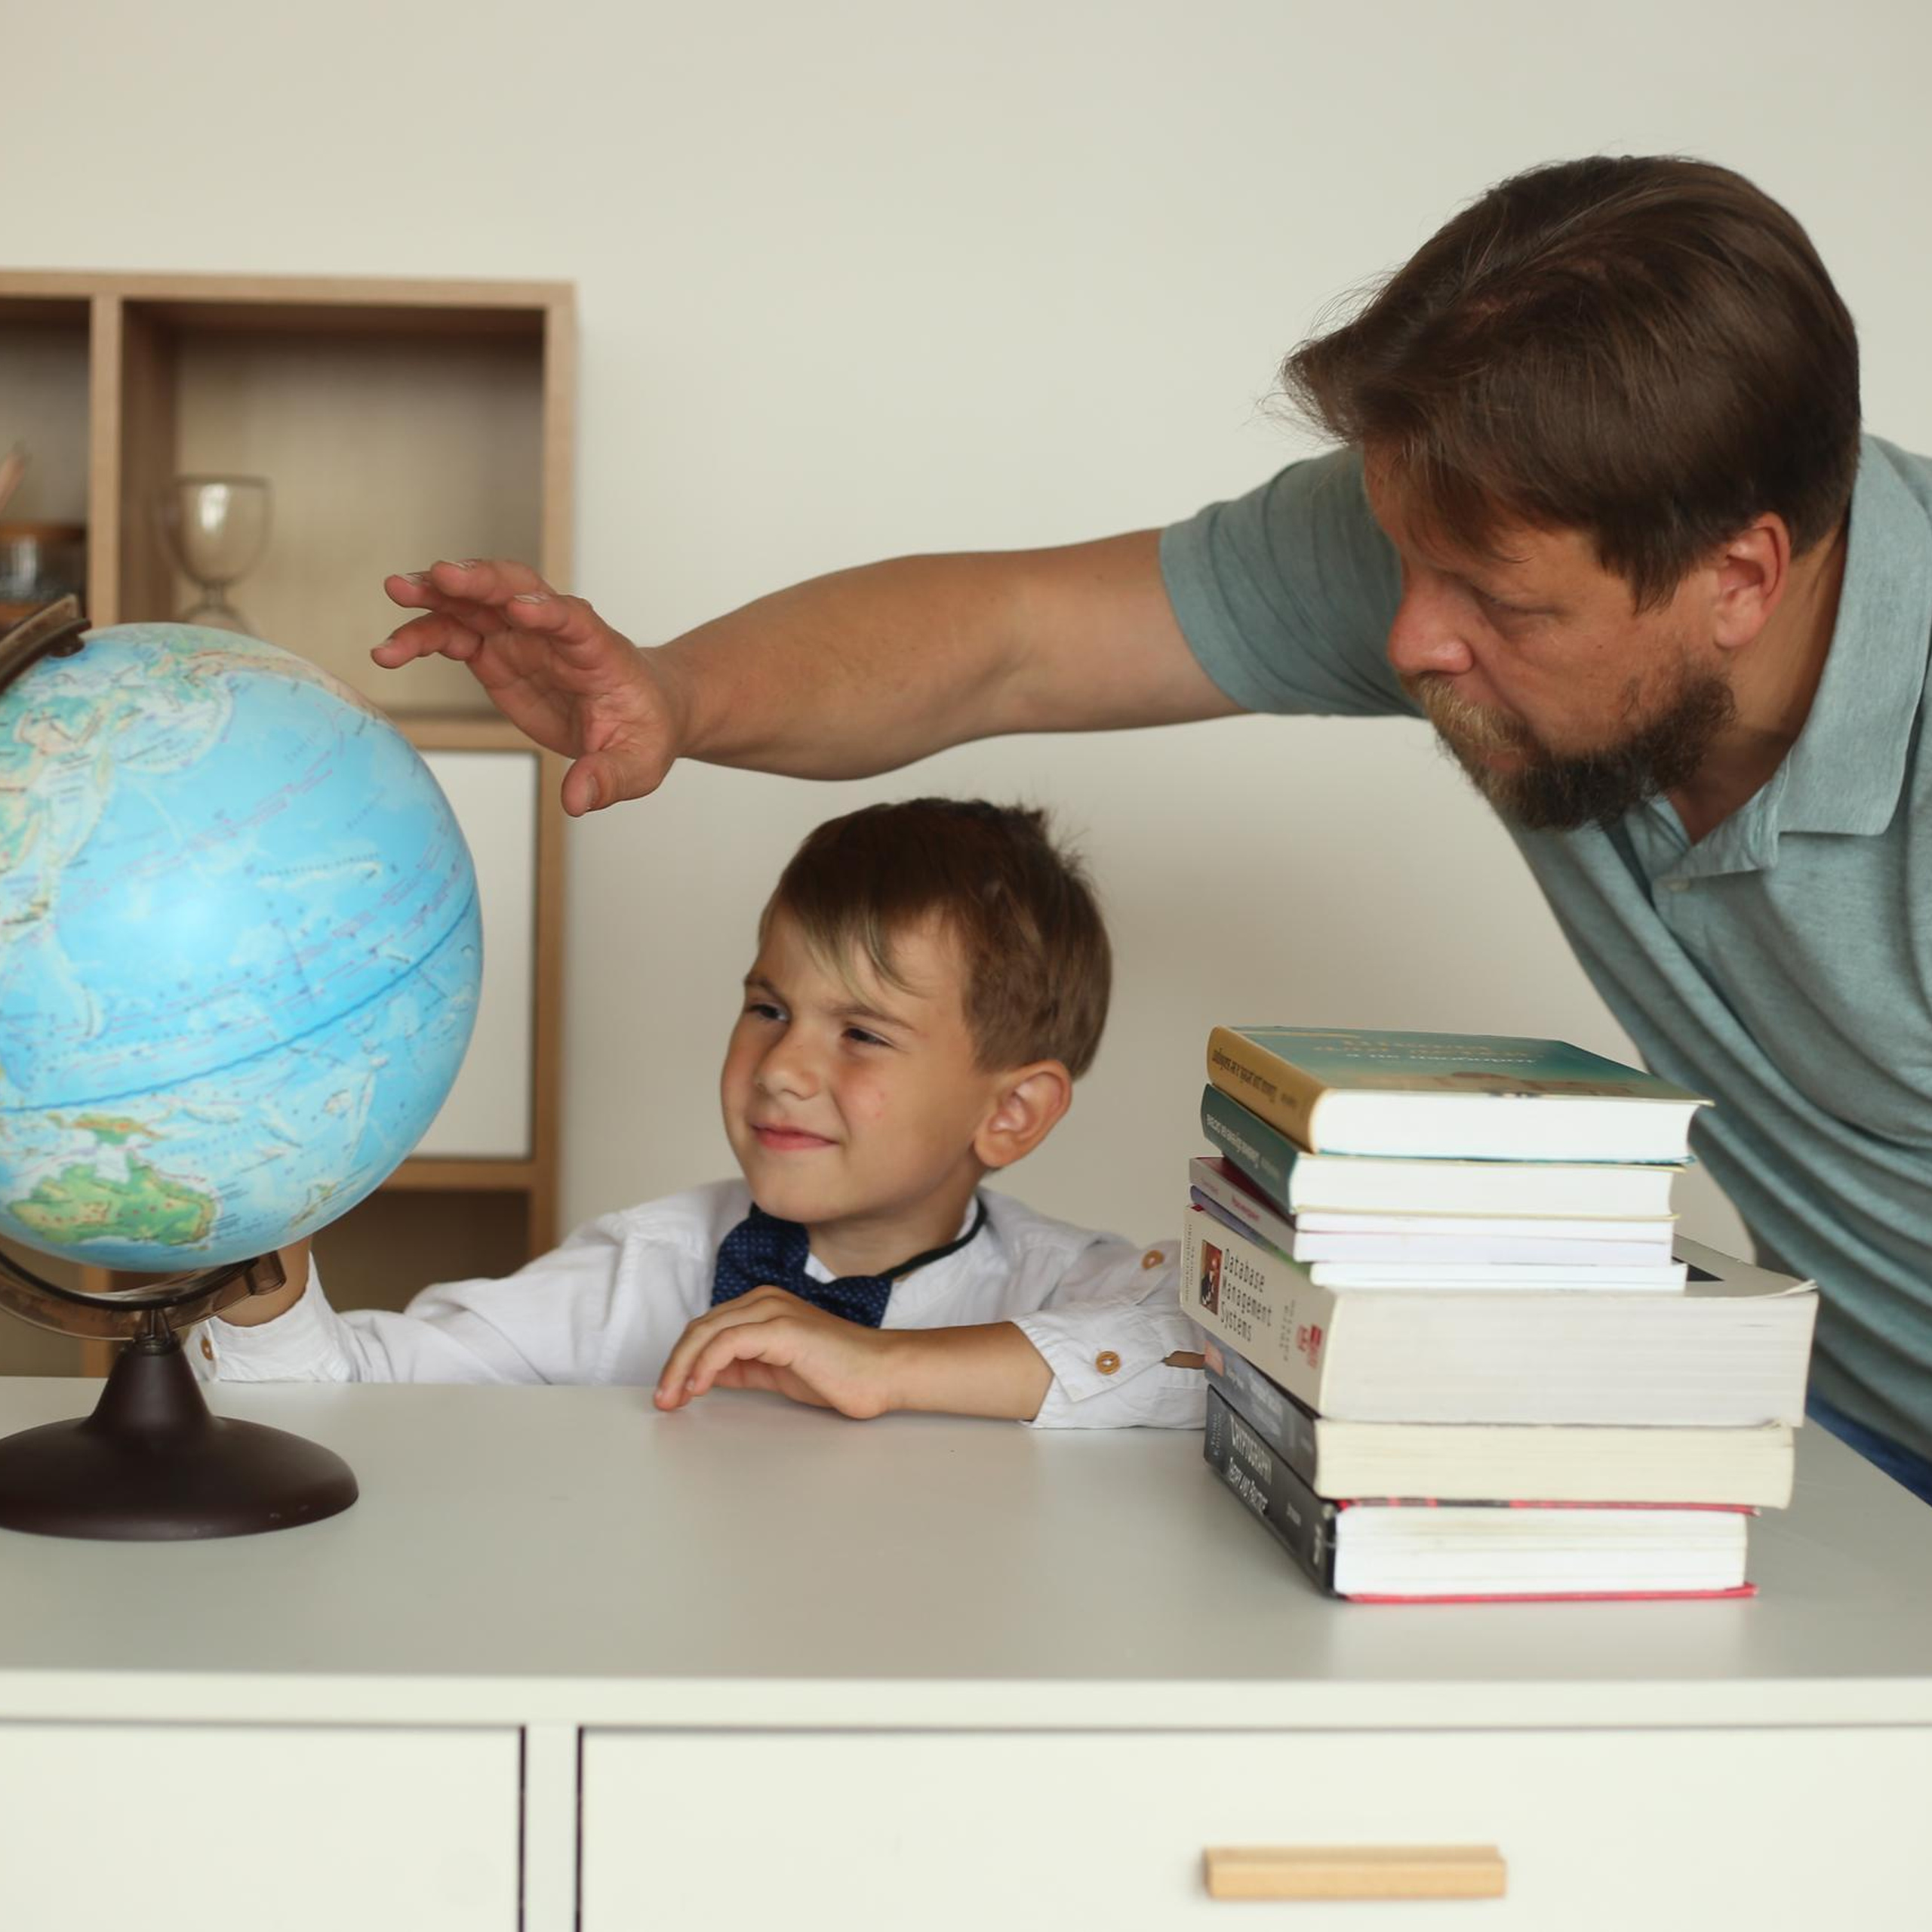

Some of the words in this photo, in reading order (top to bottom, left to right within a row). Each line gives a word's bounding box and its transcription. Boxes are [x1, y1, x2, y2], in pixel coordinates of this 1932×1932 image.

[1224, 1248, 1265, 1293] Database
[1220, 1300, 1252, 1342] Systems
[1222, 1275, 1272, 1327] Management
